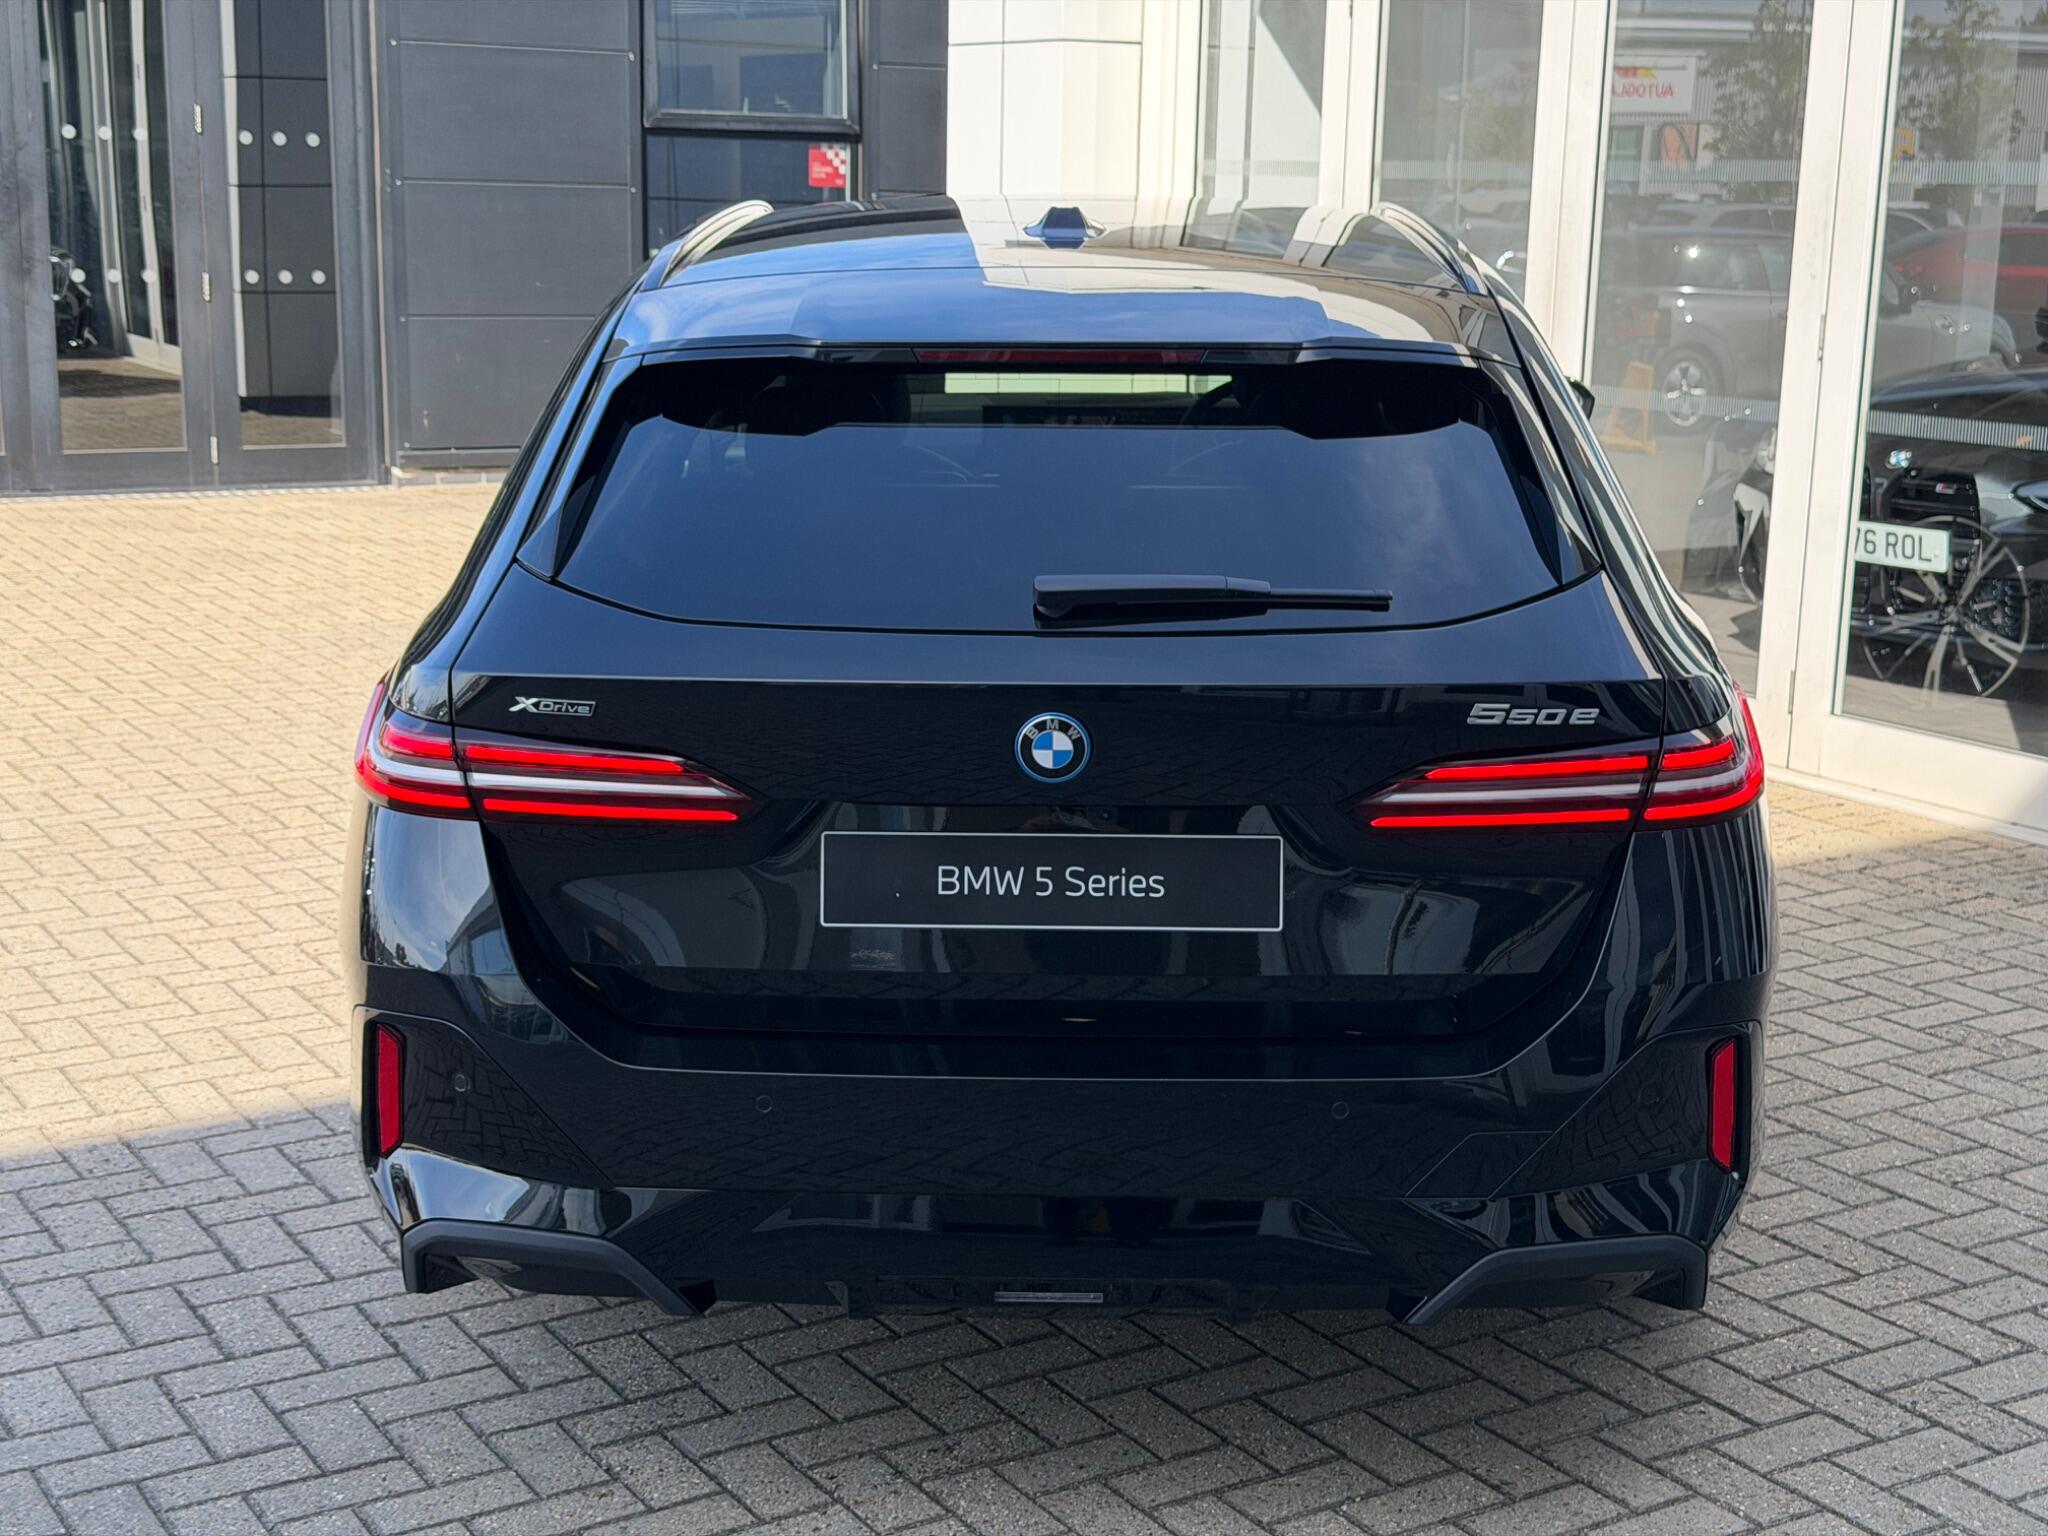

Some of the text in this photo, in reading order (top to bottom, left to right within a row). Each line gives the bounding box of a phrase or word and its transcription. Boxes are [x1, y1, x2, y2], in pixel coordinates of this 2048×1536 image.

[1885, 531, 1932, 562] ROL
[1025, 719, 1081, 741] BMW
[937, 865, 1165, 897] BMW 5 Series
